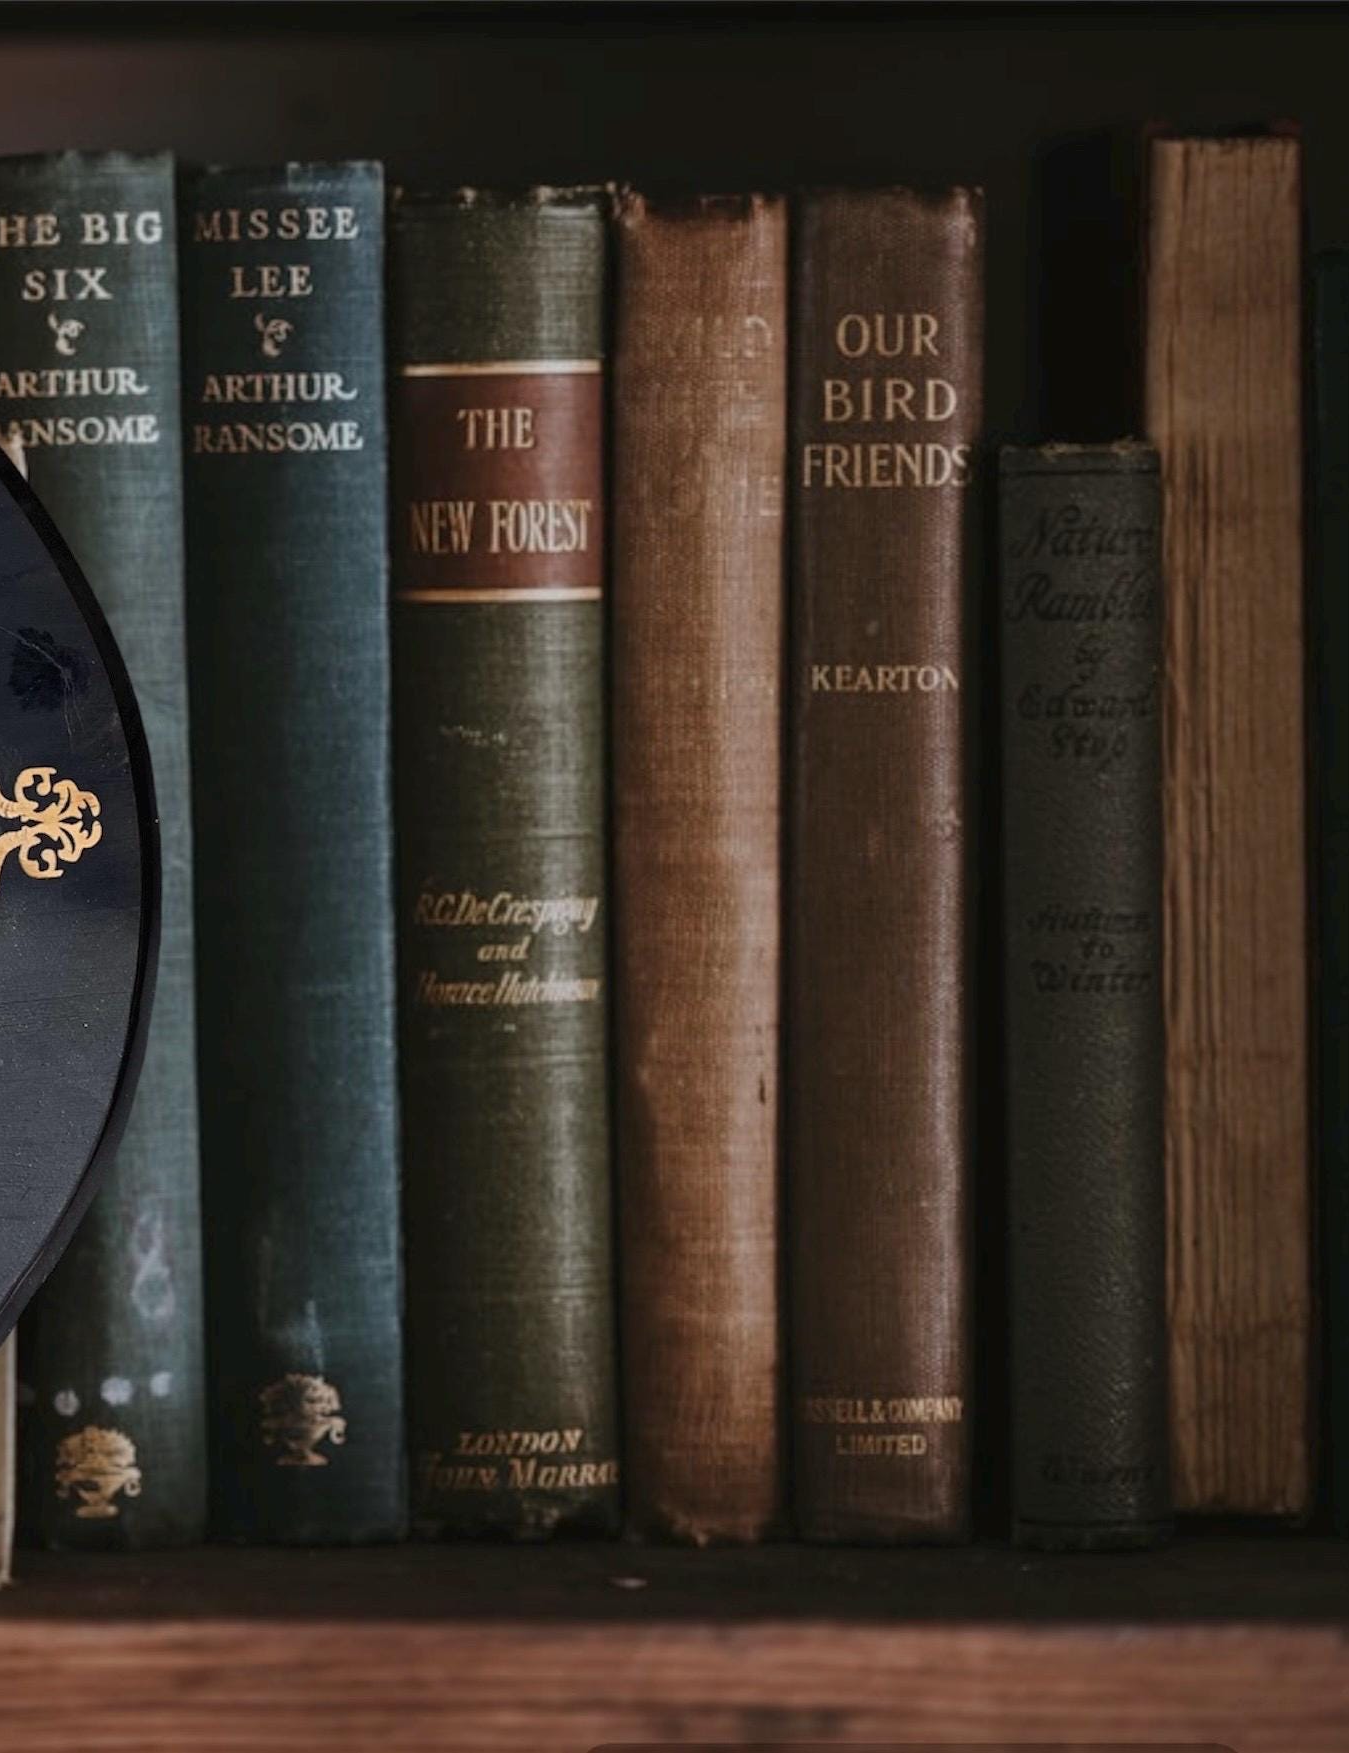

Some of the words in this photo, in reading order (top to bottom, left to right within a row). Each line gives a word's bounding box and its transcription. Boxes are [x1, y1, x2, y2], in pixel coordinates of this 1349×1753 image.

[81, 210, 163, 246] BIG
[195, 206, 360, 242] MISSEE
[22, 267, 113, 301] SIX
[231, 264, 314, 299] LEE
[836, 312, 940, 358] OUR
[203, 372, 359, 403] ARTHUR
[823, 377, 958, 424] BIRD
[195, 421, 364, 455] RANSOME
[458, 407, 536, 450] THE
[802, 442, 972, 488] FRIENDS
[411, 500, 475, 554] NEW
[489, 499, 593, 554] FOREST
[810, 664, 960, 692] KEARTON
[476, 934, 533, 963] and
[455, 1427, 585, 1456] LONDON
[836, 1433, 929, 1456] LIMITED
[505, 1458, 619, 1490] MURRA
